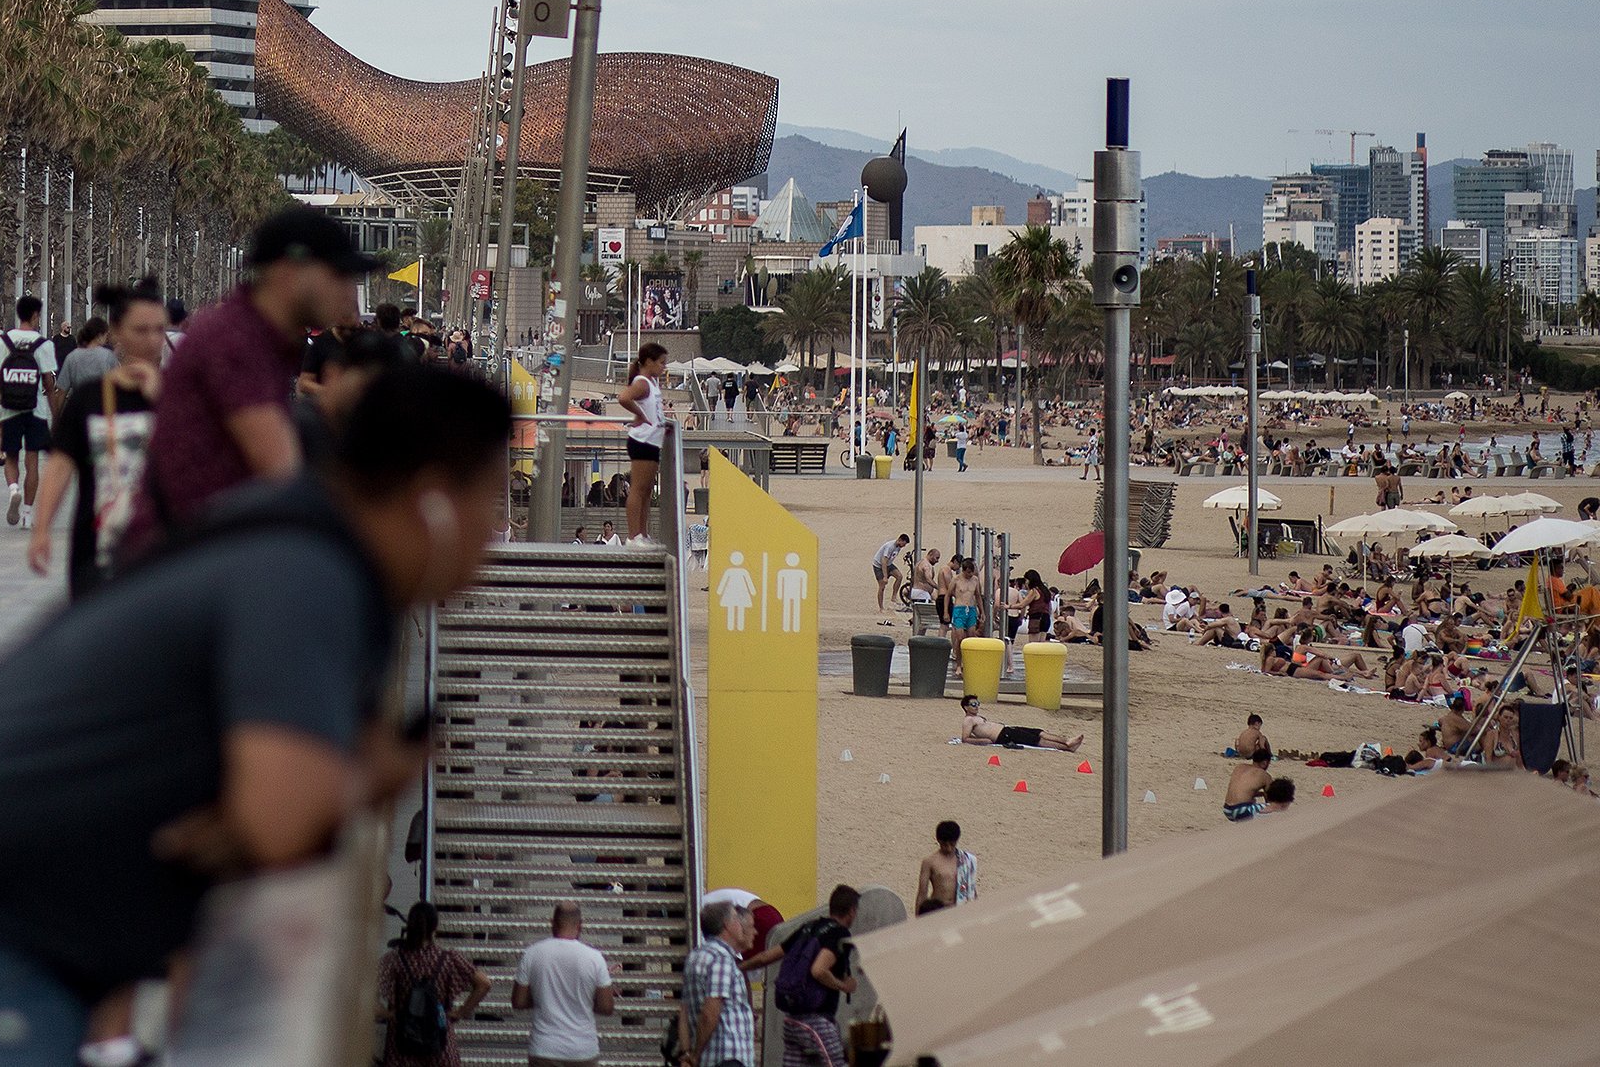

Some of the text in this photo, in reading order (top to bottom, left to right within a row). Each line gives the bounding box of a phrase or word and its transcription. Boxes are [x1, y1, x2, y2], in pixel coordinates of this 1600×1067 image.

[601, 241, 608, 253] I
[648, 278, 678, 288] OPIUM
[3, 368, 38, 384] VANS
